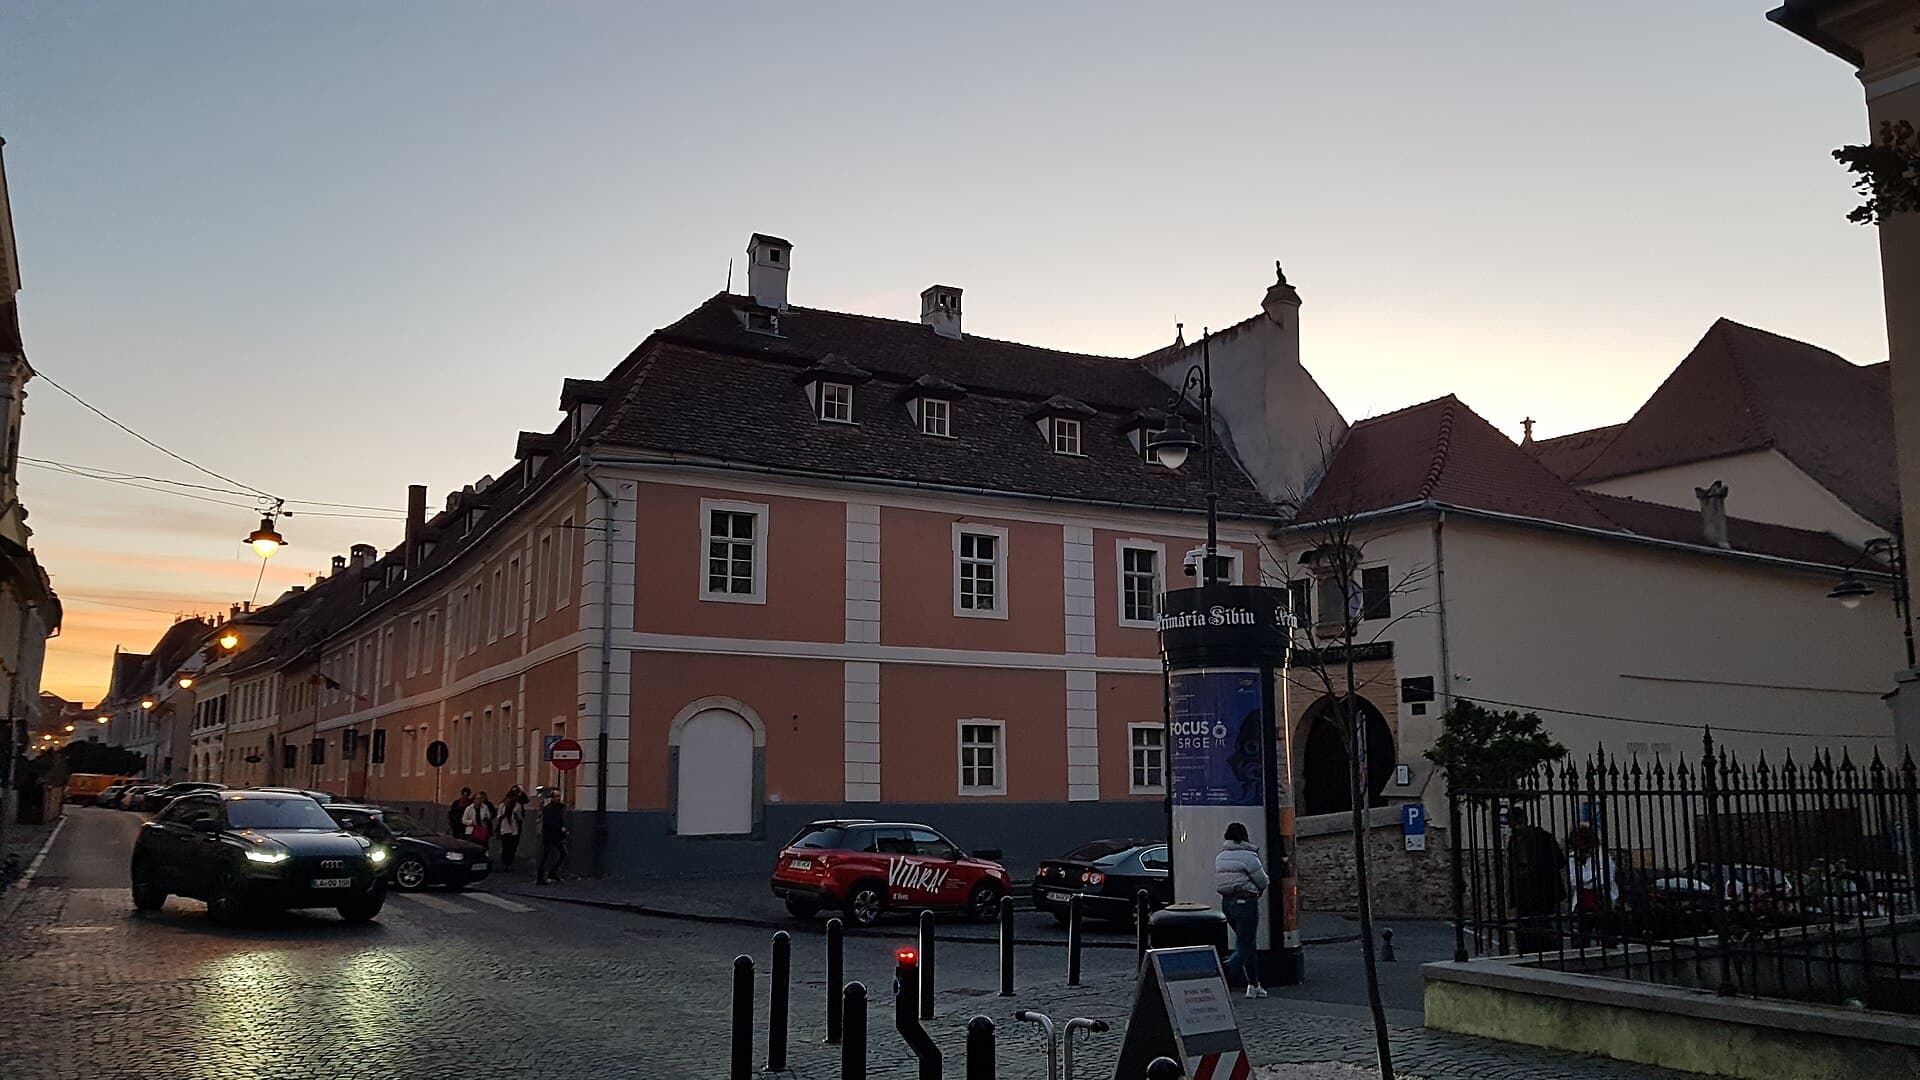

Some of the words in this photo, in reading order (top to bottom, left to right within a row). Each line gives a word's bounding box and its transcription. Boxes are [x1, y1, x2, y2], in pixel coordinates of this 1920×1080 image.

[1208, 605, 1256, 626] Sibiu
[1170, 721, 1210, 737] FOCUS
[1178, 737, 1210, 749] SRGE
[1408, 807, 1418, 825] P
[888, 856, 949, 894] VITARA!
